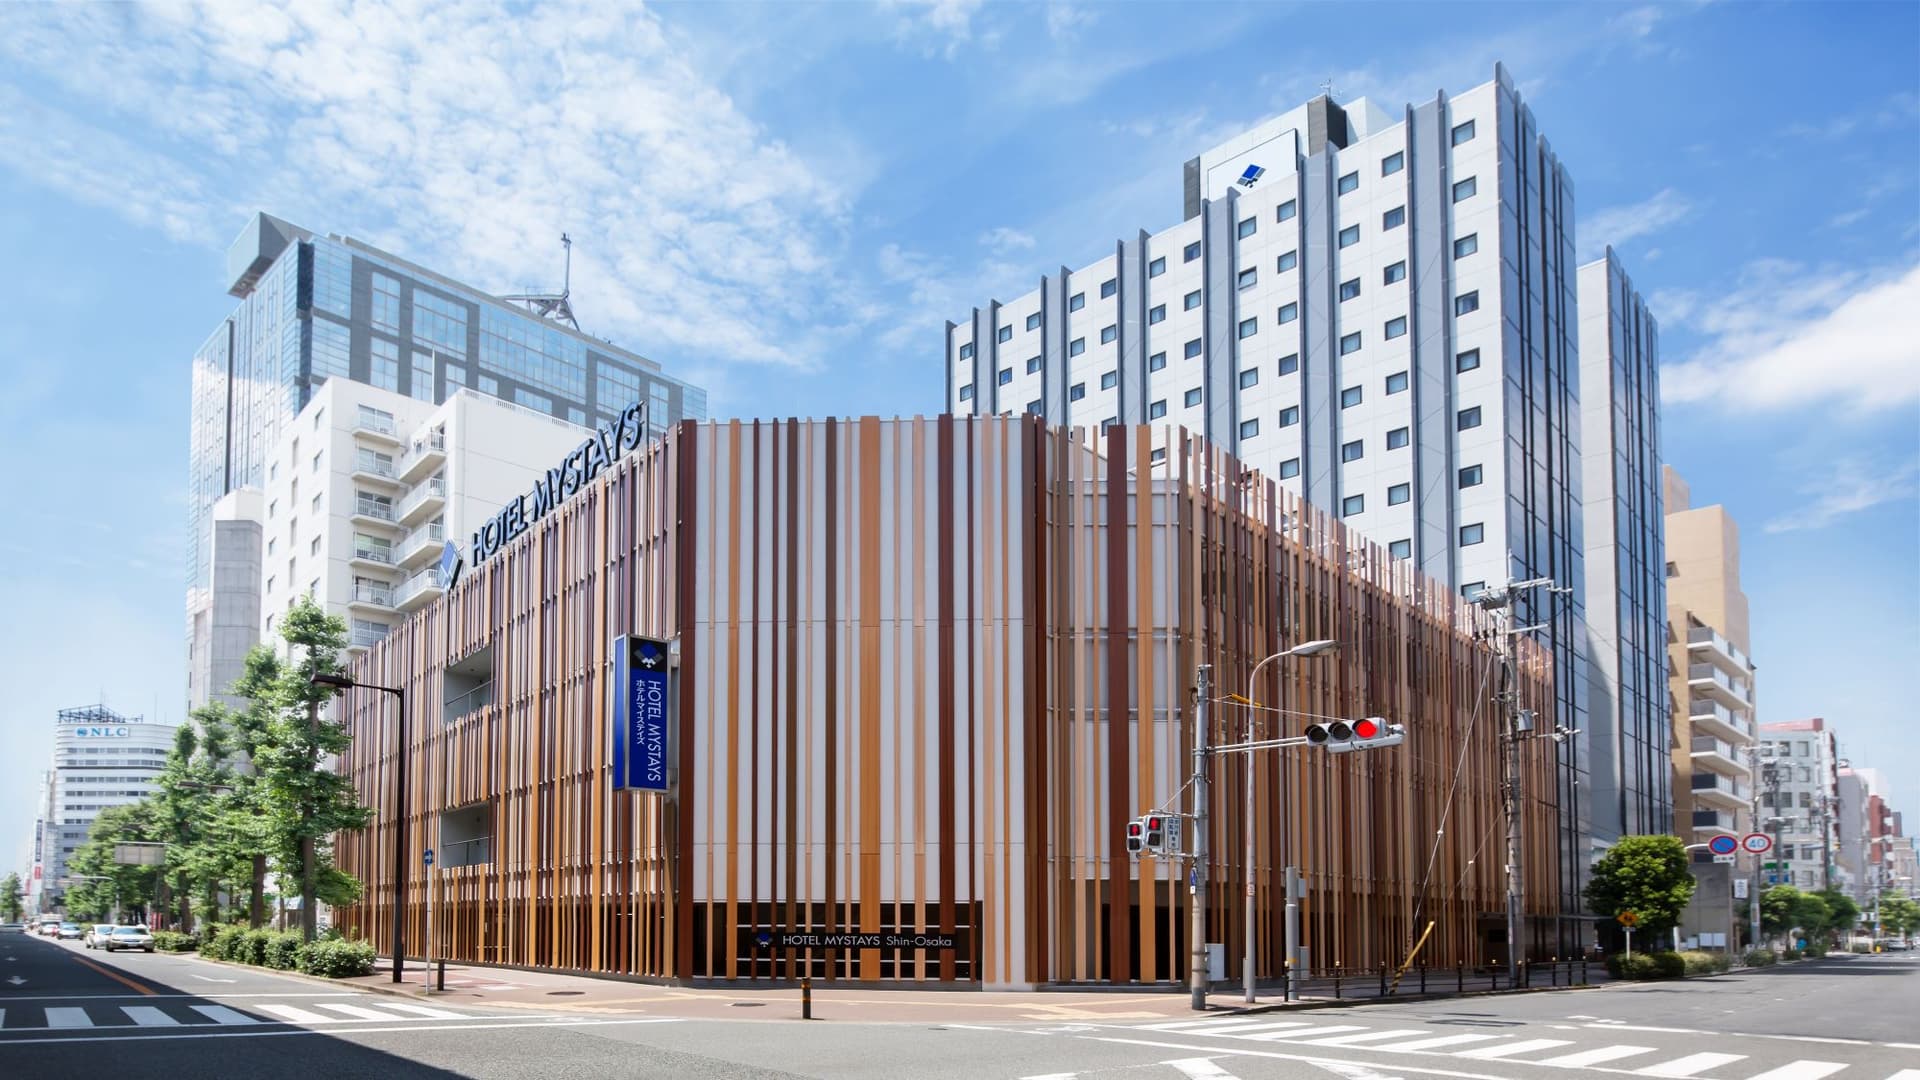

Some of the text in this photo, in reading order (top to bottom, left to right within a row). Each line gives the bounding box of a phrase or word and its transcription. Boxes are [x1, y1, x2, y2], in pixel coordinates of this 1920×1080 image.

[472, 401, 642, 567] HOTEL MYSTAYS
[91, 727, 126, 736] NLC
[648, 680, 661, 782] HOTEL MYSTAYS
[1748, 838, 1766, 848] 40
[783, 935, 952, 947] HOTEL MYSTAYS Shin-Osaka
